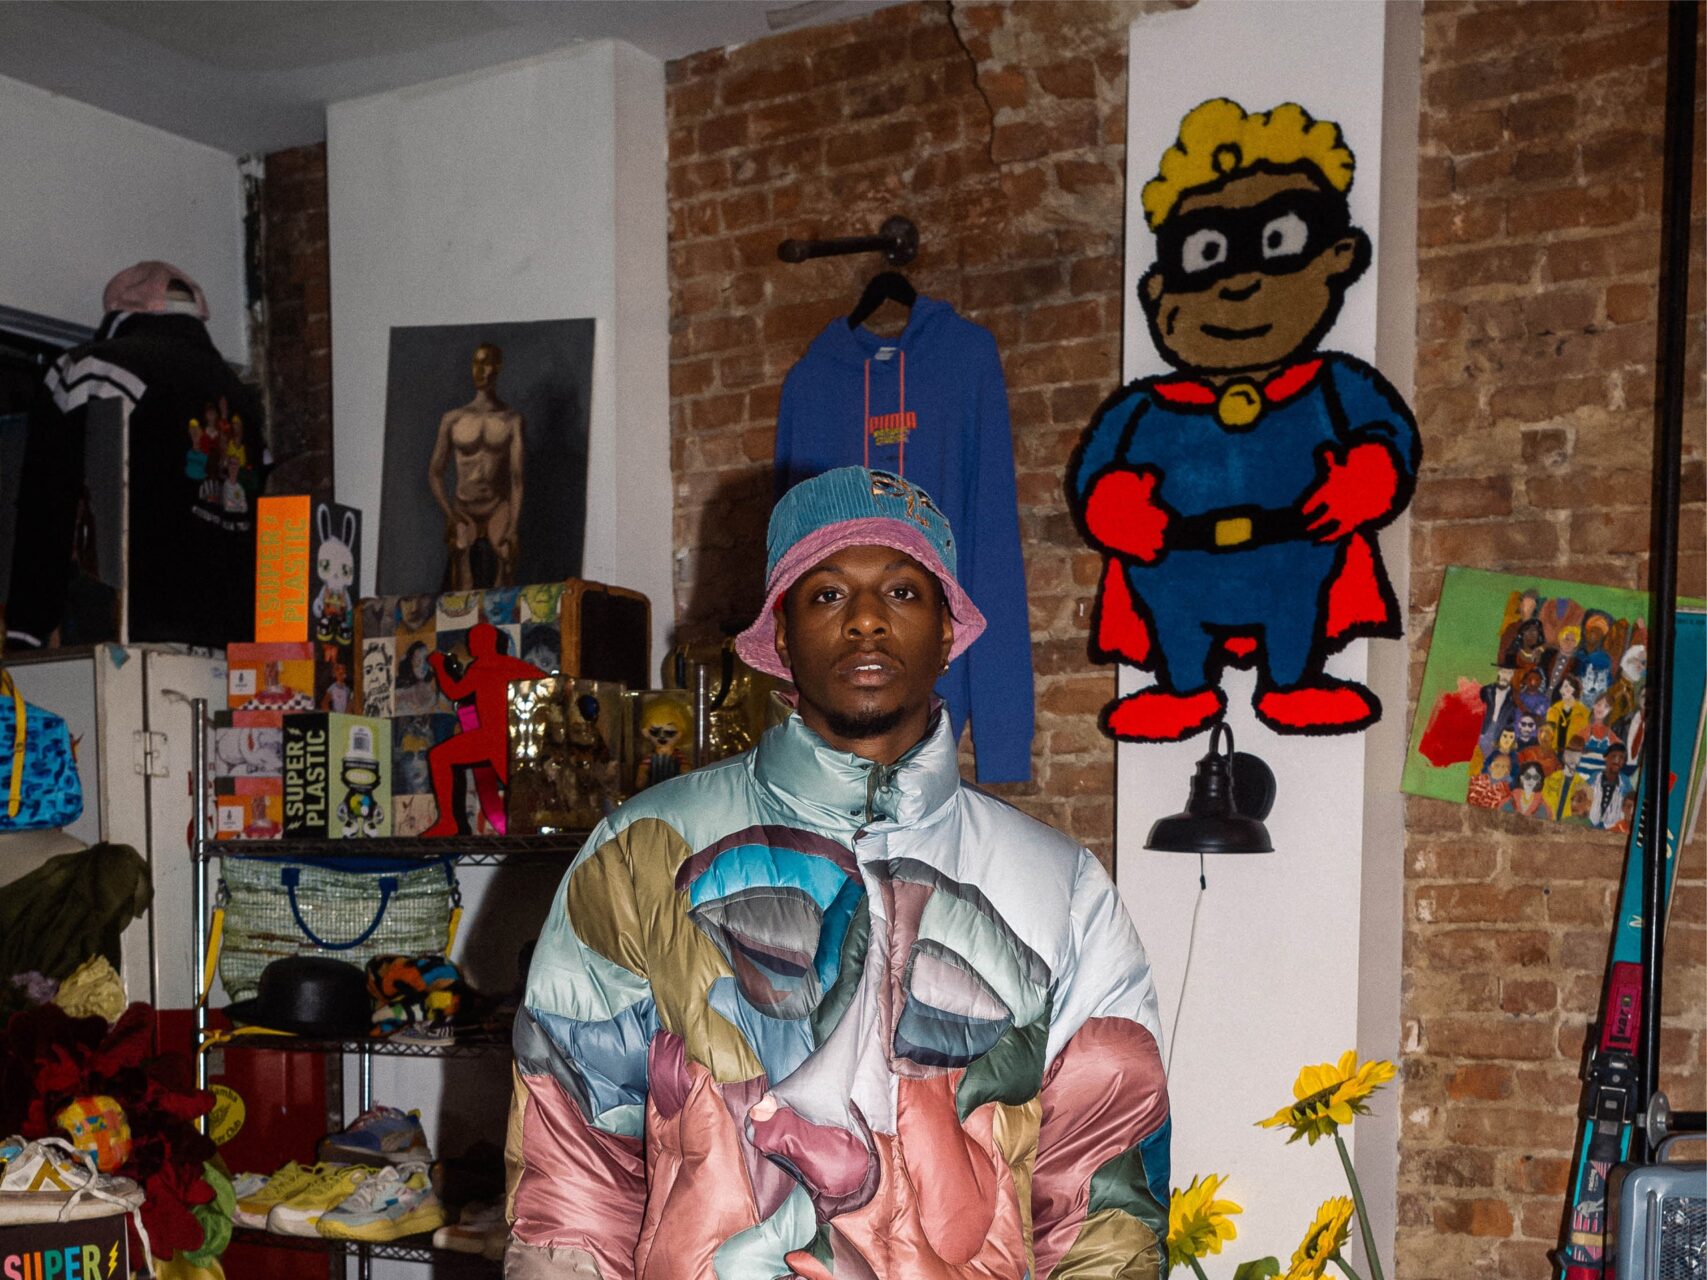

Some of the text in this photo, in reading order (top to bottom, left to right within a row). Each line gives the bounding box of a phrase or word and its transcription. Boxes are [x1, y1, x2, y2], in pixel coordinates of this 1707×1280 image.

[259, 530, 281, 613] SUPER
[284, 518, 306, 623] PLASTIC
[286, 739, 305, 817] SUPER
[306, 729, 325, 827] PLASTIC
